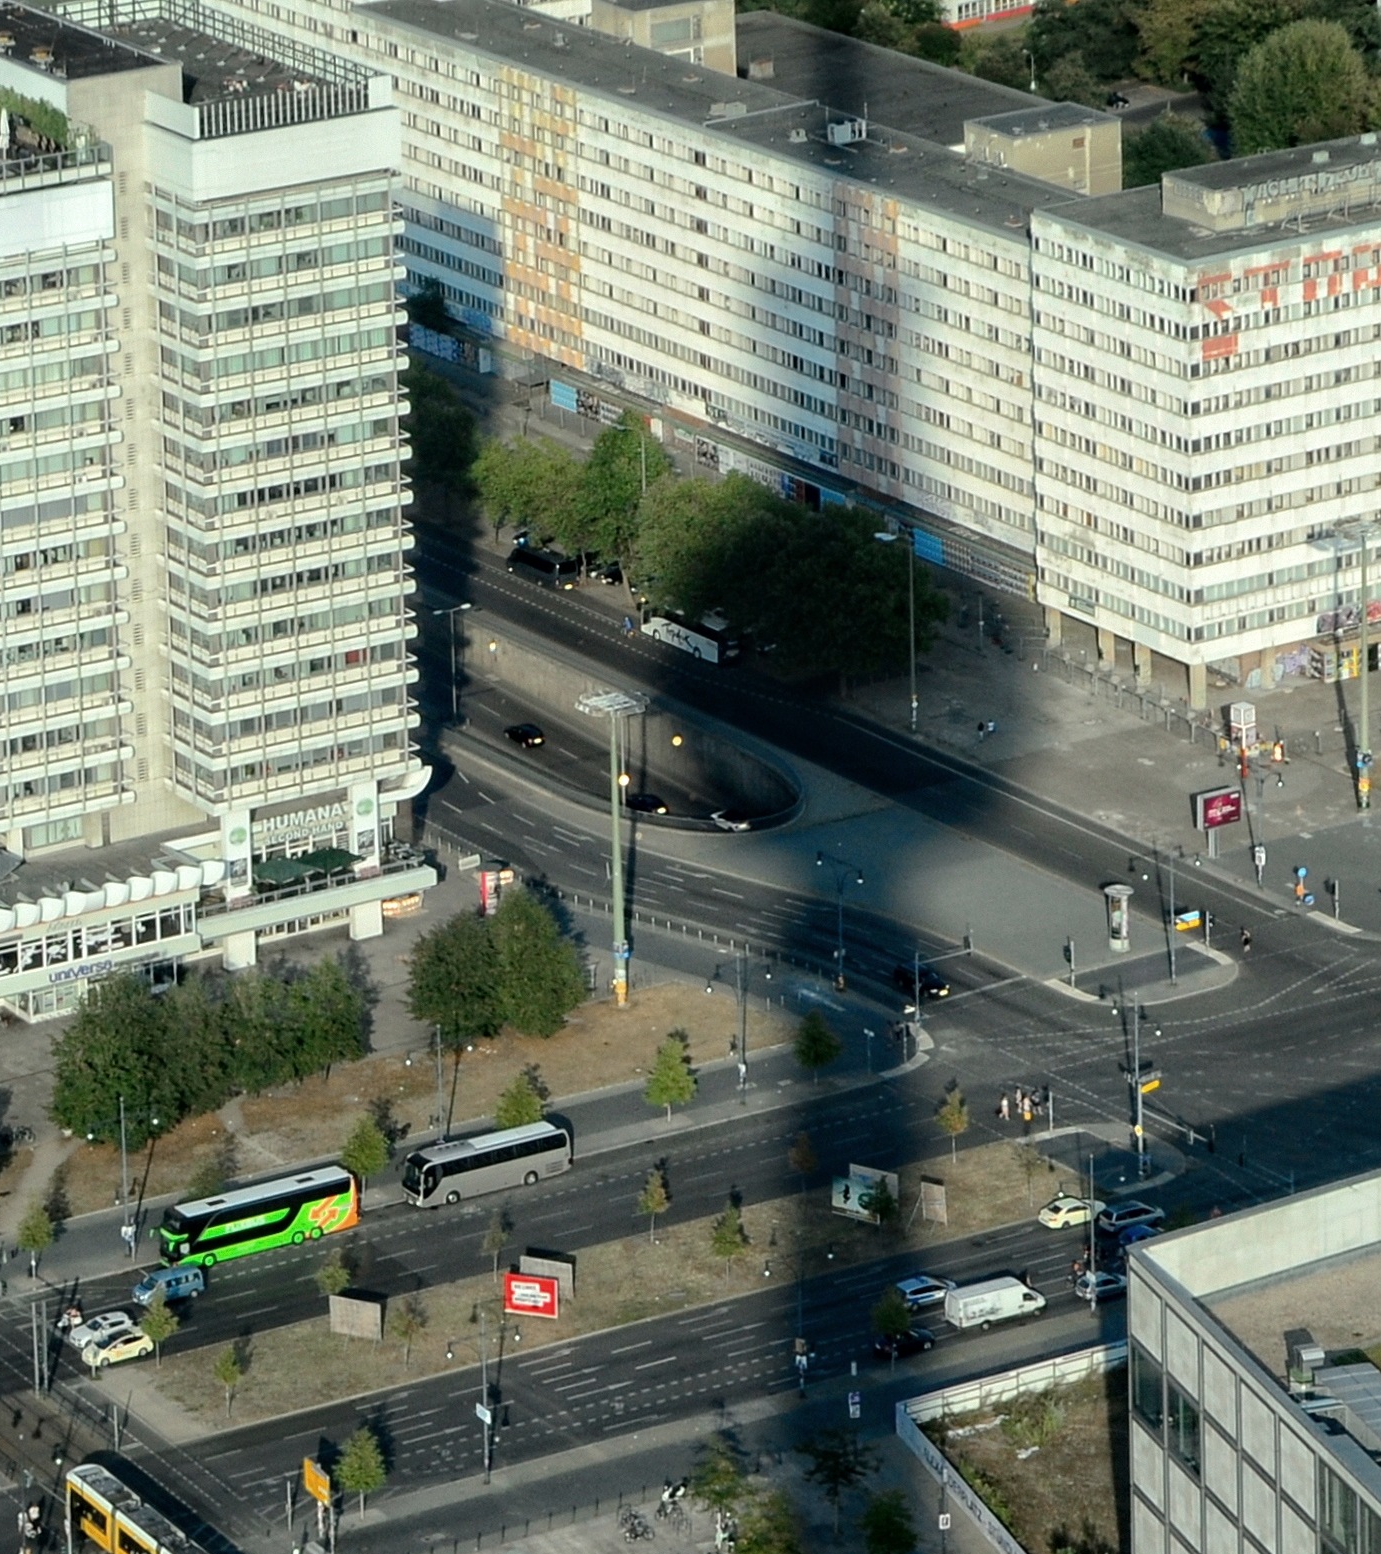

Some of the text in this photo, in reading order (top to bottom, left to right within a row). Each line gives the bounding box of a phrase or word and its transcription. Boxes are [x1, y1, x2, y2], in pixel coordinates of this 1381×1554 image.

[263, 802, 343, 832] HUMANA
[267, 820, 344, 845] SECOND HAND
